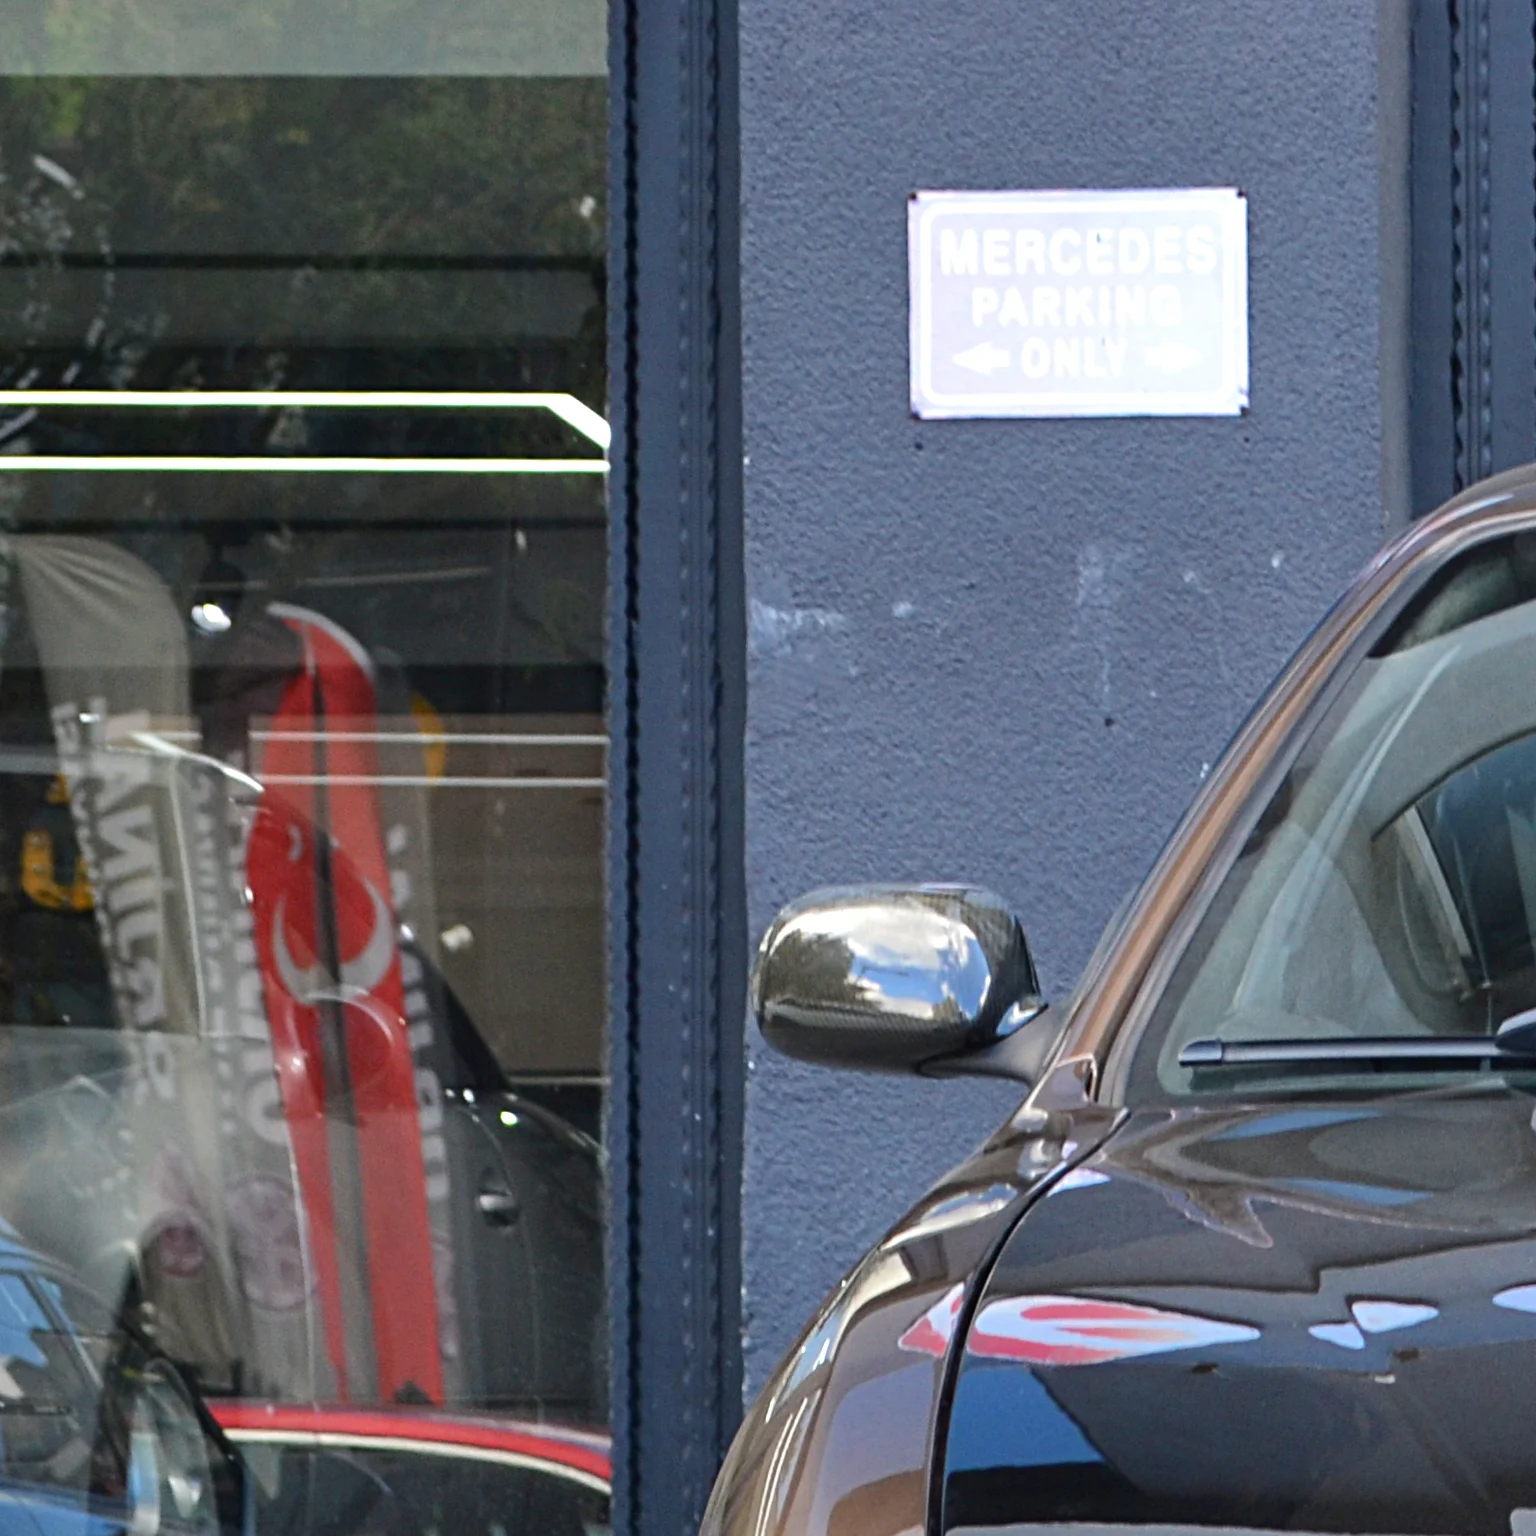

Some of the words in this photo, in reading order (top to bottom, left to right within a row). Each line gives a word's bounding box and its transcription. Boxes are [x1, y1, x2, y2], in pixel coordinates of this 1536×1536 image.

[939, 224, 1218, 277] MERCEDES
[970, 284, 1183, 328] PARKING
[1020, 336, 1129, 379] ONLY
